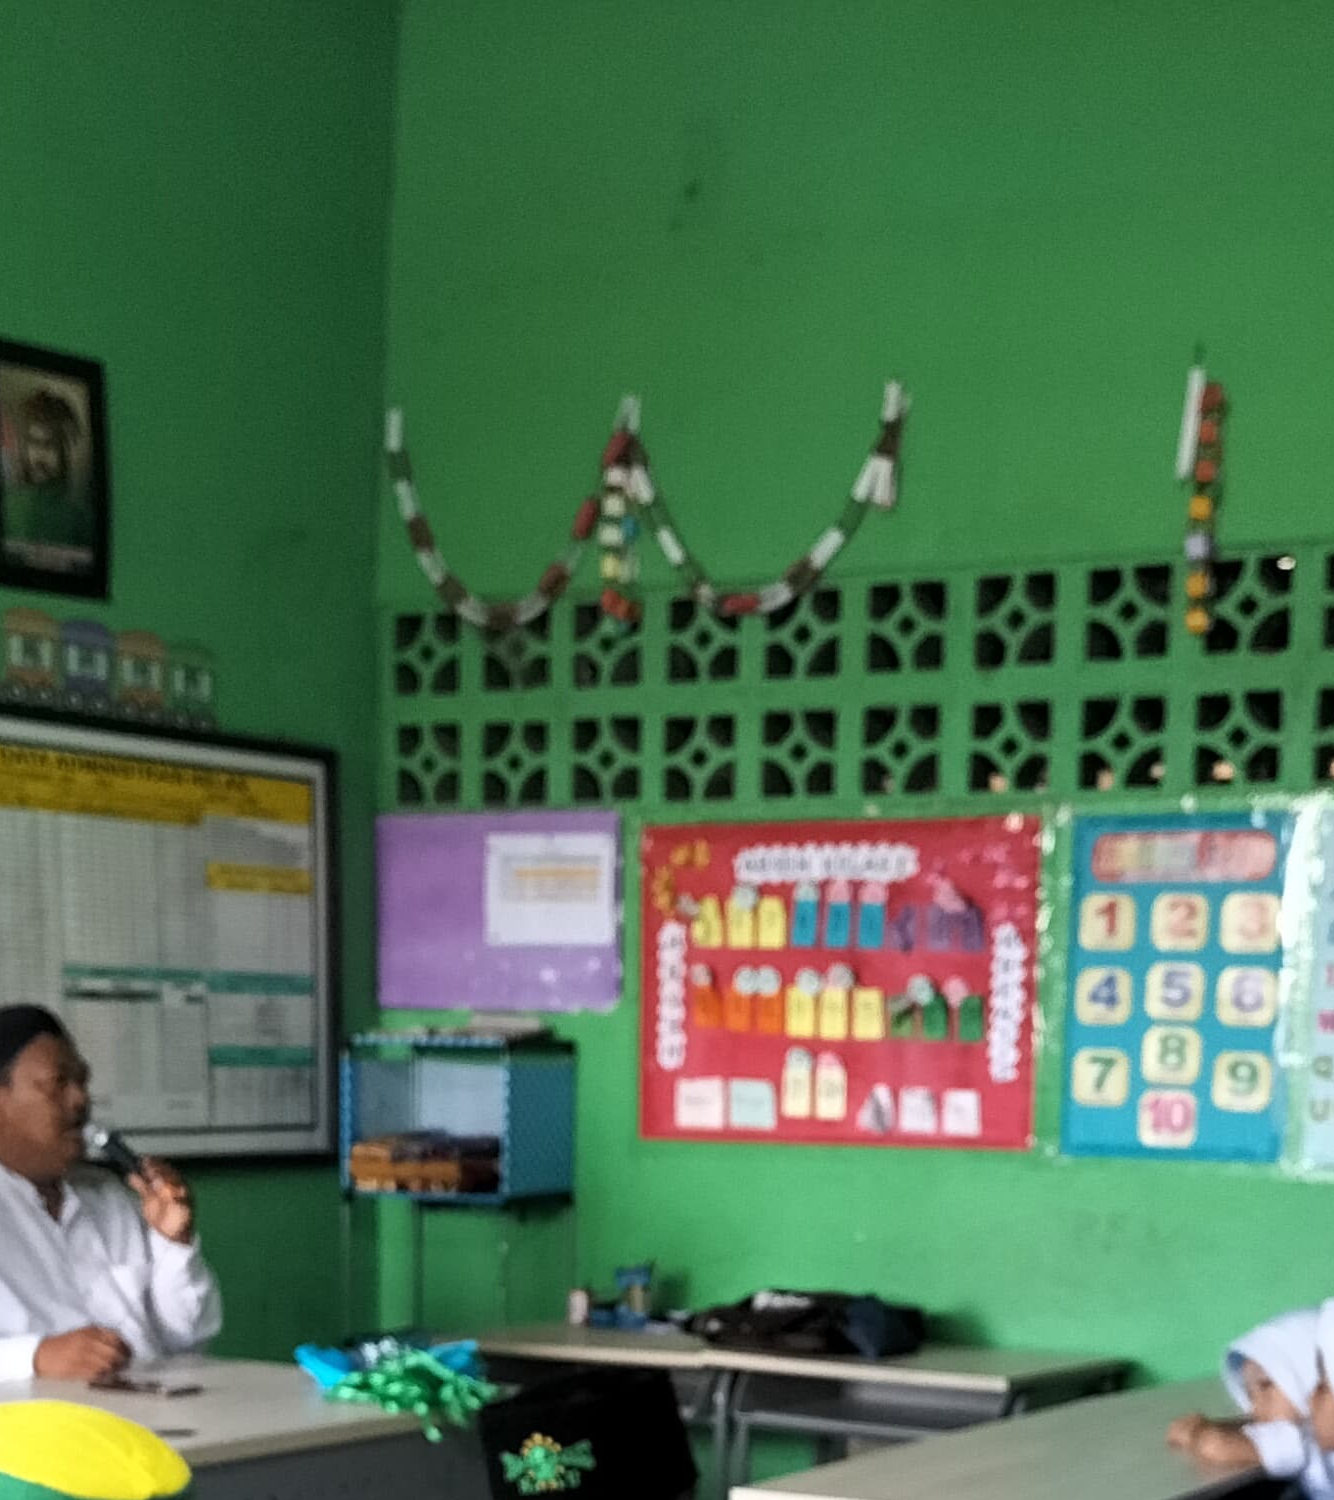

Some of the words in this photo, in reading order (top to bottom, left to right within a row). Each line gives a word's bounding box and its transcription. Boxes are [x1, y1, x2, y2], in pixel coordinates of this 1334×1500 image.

[1093, 902, 1120, 937] 1
[1167, 899, 1199, 940] 2
[1238, 900, 1268, 943] 3
[1088, 973, 1120, 1010] 4
[1161, 970, 1192, 1009] 5
[1230, 974, 1265, 1013] 6
[1156, 1030, 1187, 1070] 8
[1087, 1056, 1116, 1093] 7
[1227, 1057, 1259, 1096] 9
[1146, 1098, 1196, 1135] 10
